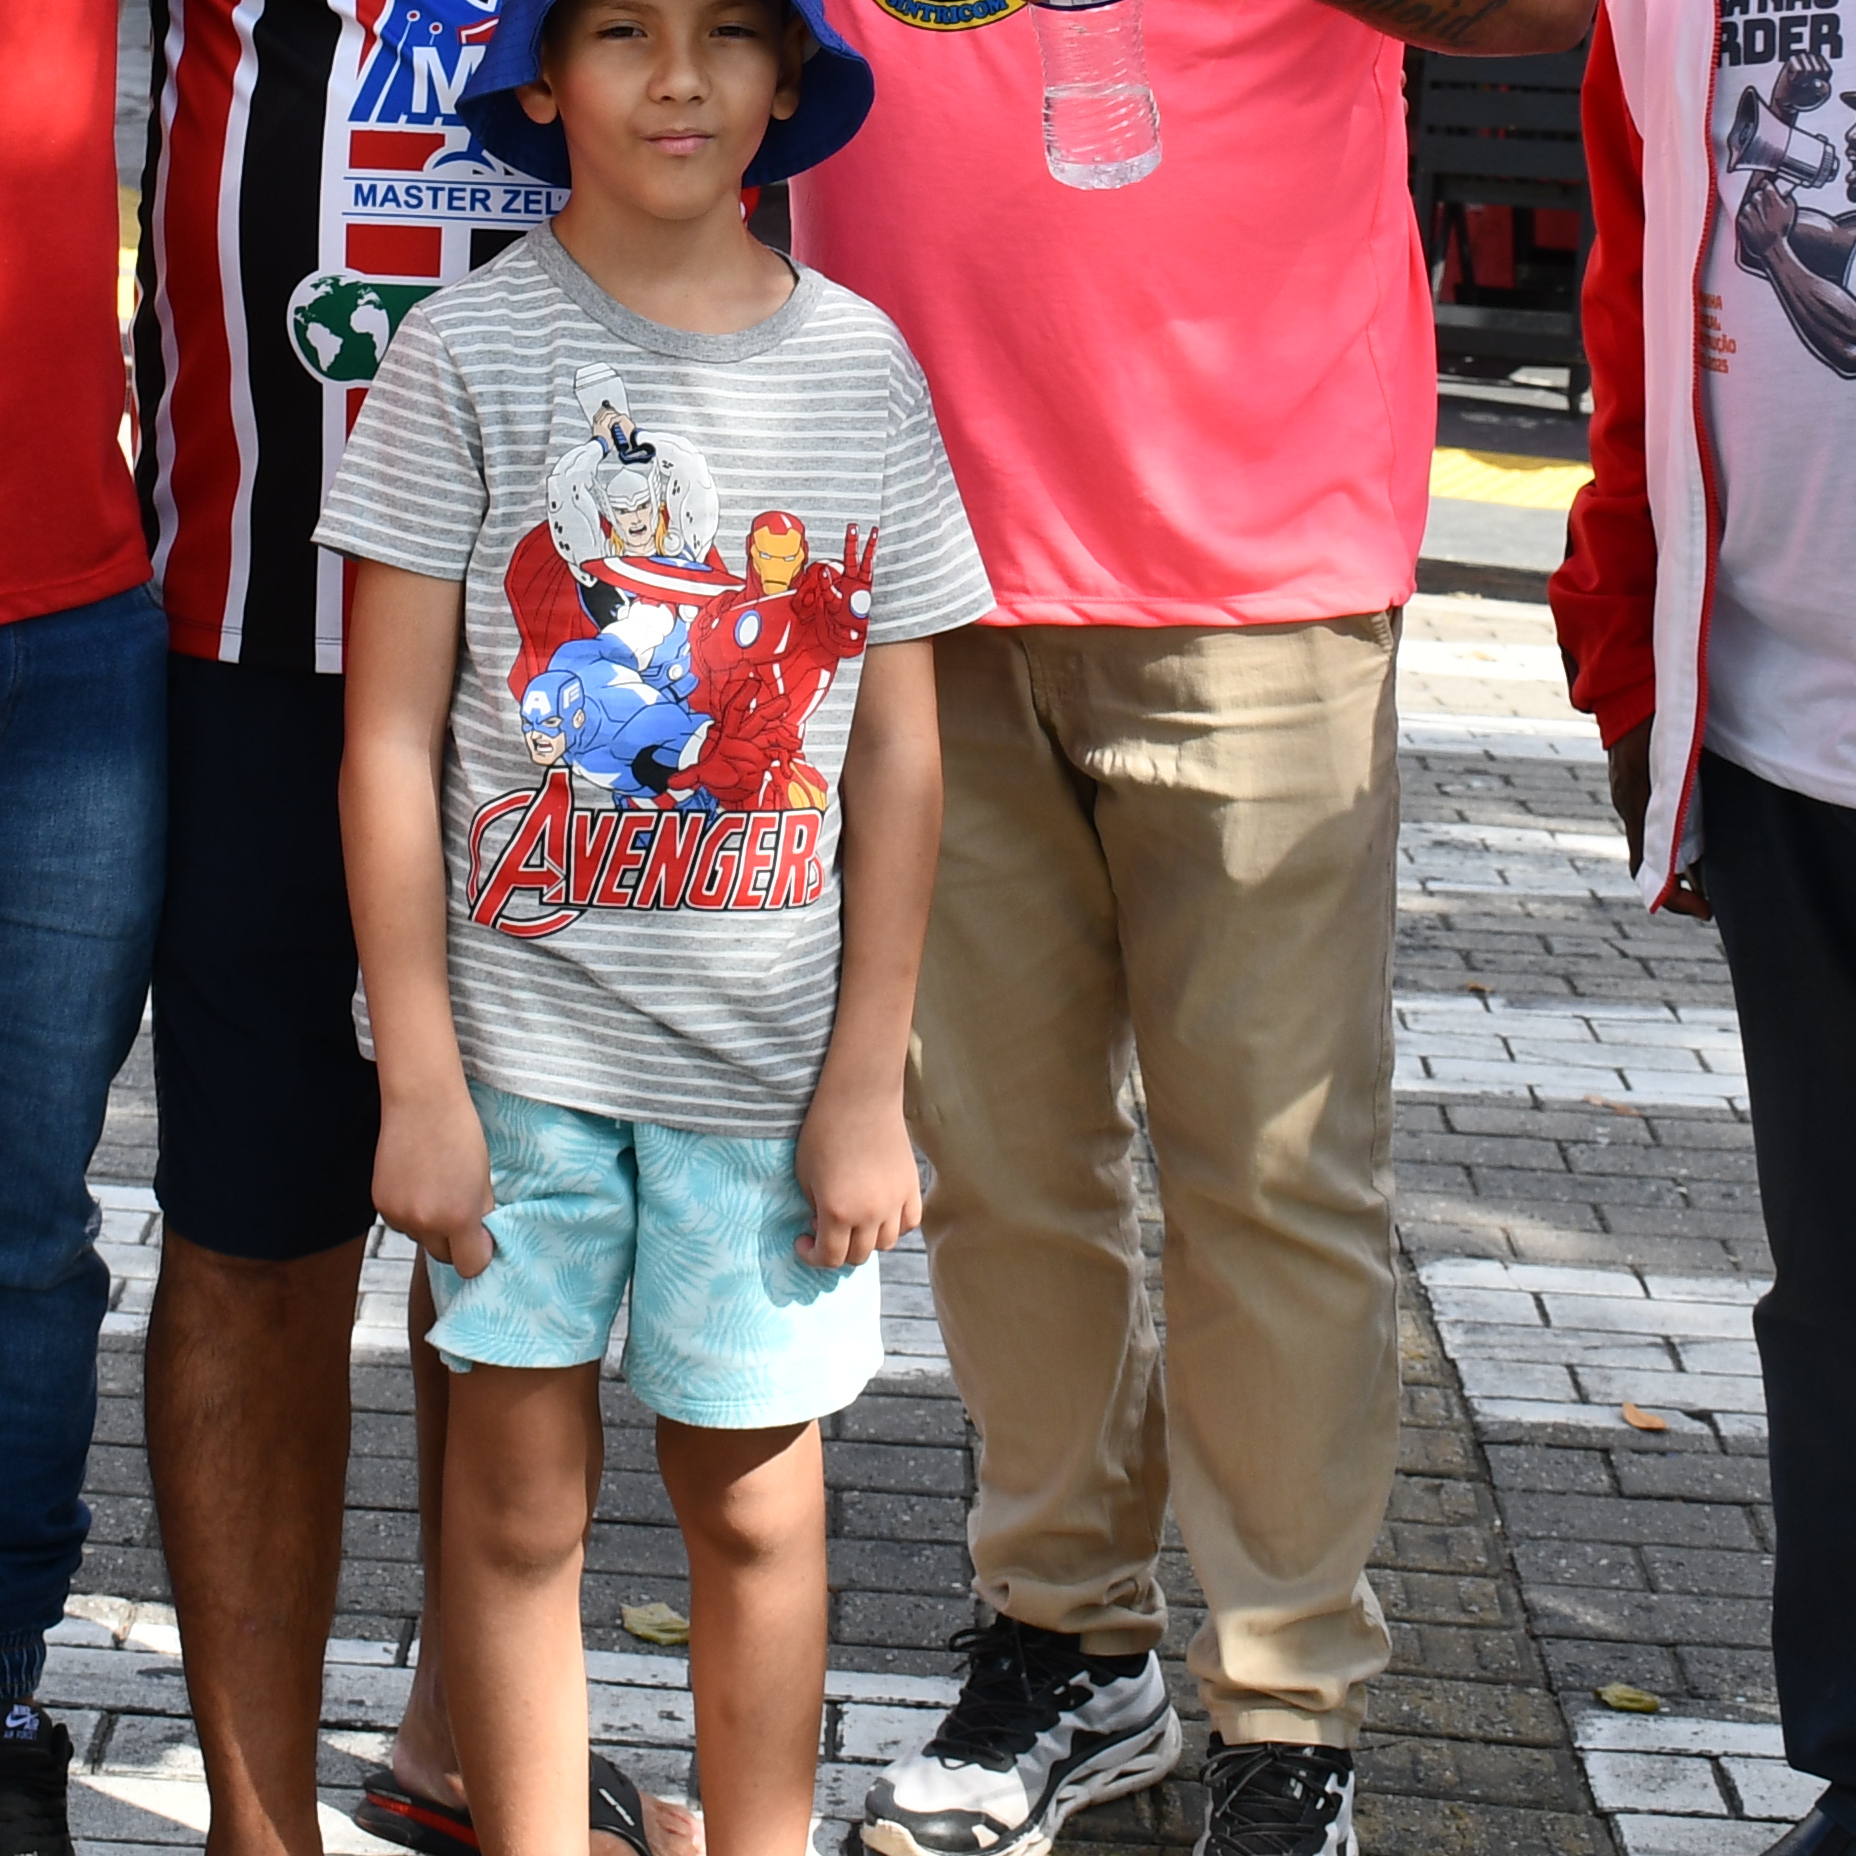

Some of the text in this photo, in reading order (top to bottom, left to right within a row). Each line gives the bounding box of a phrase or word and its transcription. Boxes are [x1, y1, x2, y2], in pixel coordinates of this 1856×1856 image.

[1718, 12, 1843, 69] RDER
[353, 183, 563, 216] MASTER ZEL
